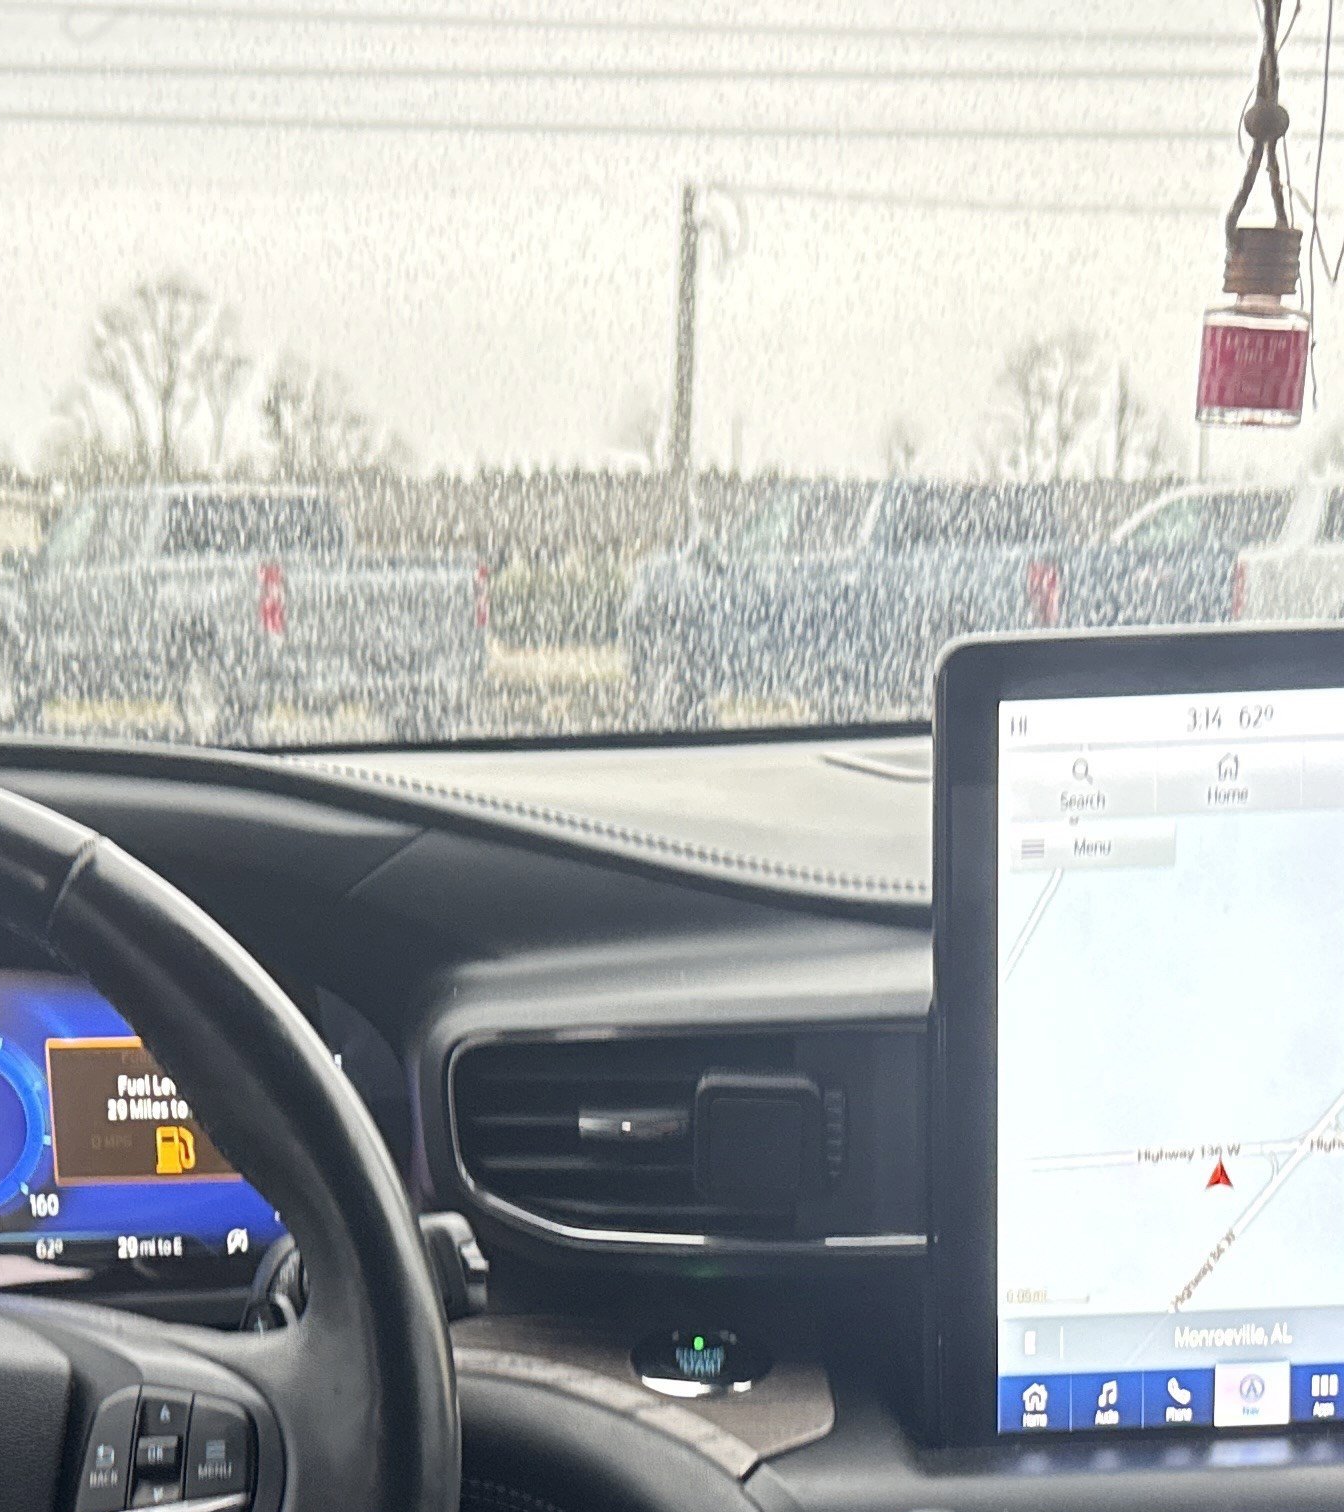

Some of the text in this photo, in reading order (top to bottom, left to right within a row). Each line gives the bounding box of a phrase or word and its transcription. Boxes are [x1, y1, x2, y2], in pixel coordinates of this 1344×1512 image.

[1060, 789, 1106, 812] Search
[1207, 786, 1249, 805] Home
[1073, 838, 1112, 857] Menu
[117, 1073, 151, 1097] Fuel
[129, 1098, 169, 1121] Miles
[1137, 1148, 1195, 1165] Highway
[29, 1193, 60, 1218] 160
[1173, 1321, 1293, 1348] Monroeville, AL
